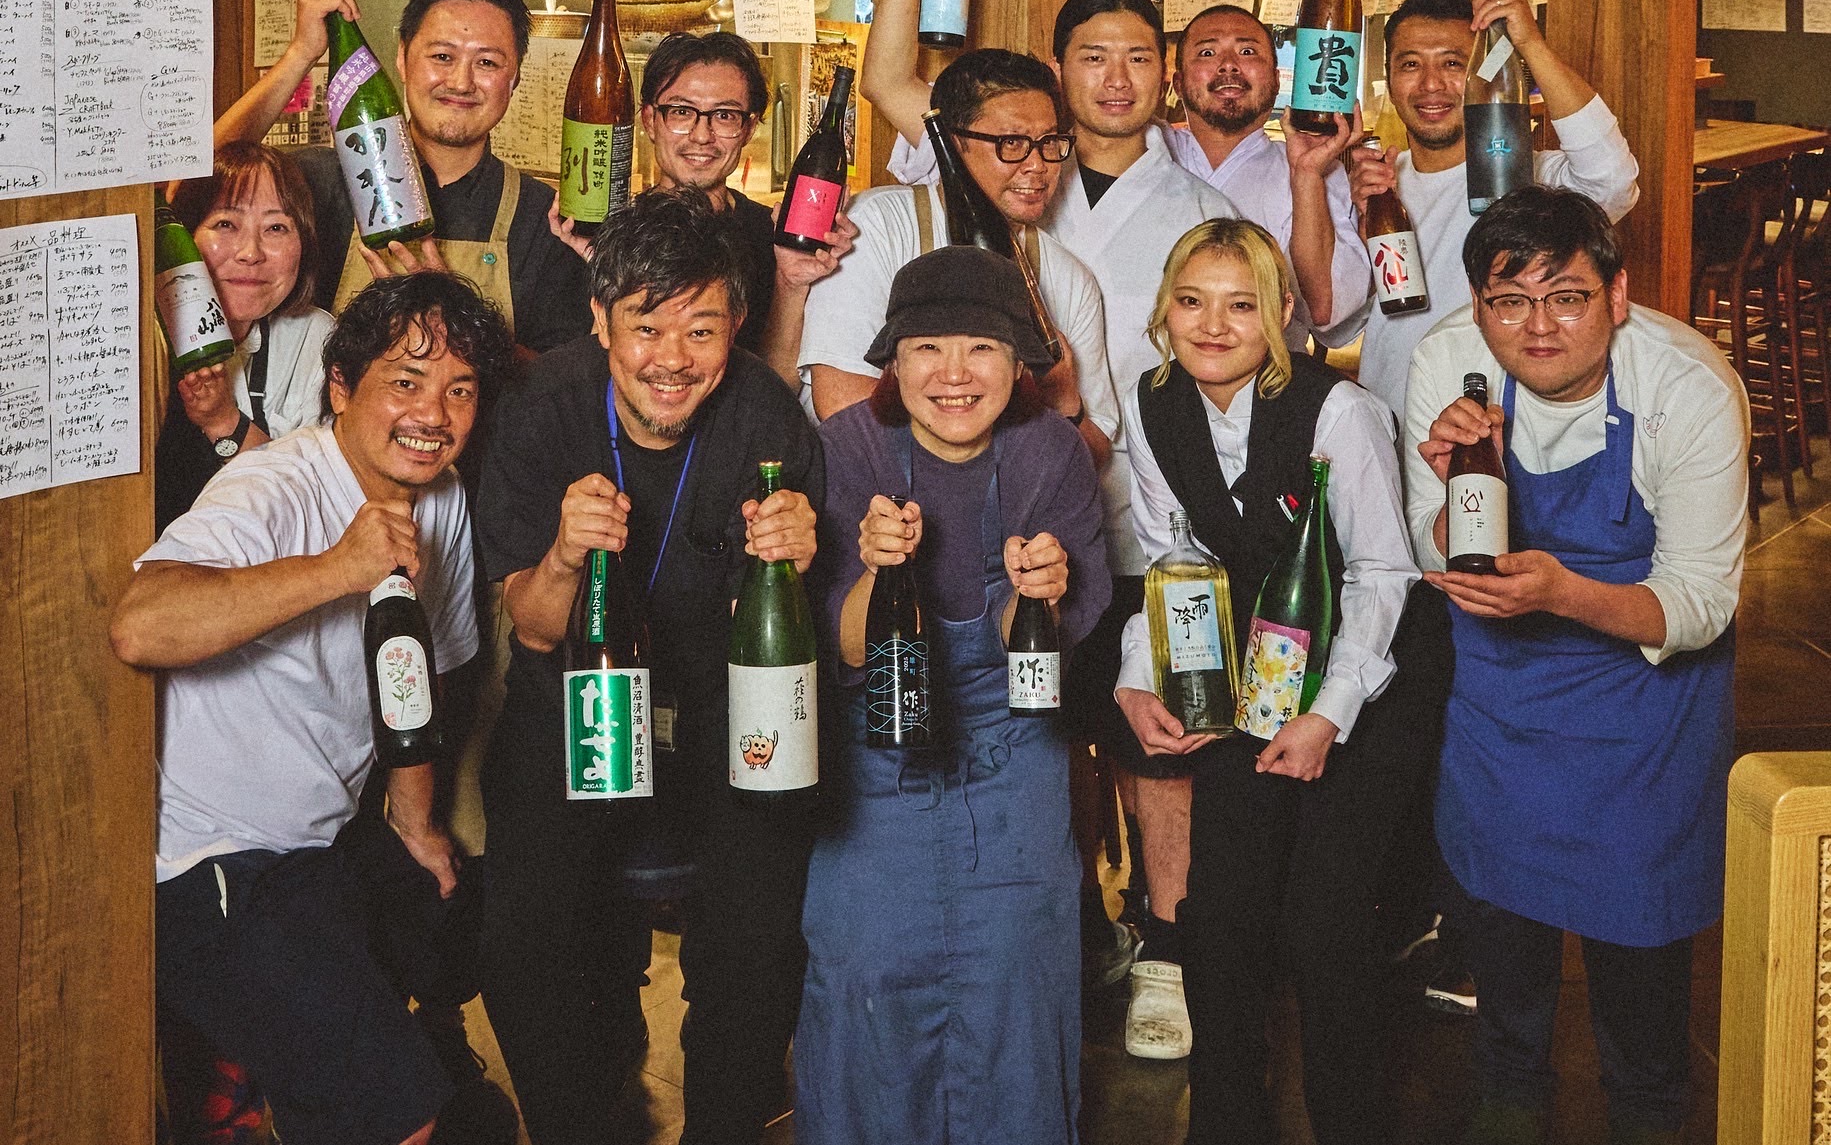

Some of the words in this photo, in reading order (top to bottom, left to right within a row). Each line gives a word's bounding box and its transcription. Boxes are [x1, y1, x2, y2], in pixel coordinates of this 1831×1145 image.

[1308, 33, 1355, 100] 貴
[593, 129, 609, 168] 純米吟醸
[1374, 242, 1409, 295] 八仙
[198, 297, 225, 335] 八海山
[1017, 658, 1044, 690] 作
[632, 674, 644, 726] 魚沼清酒
[902, 690, 919, 709] 作
